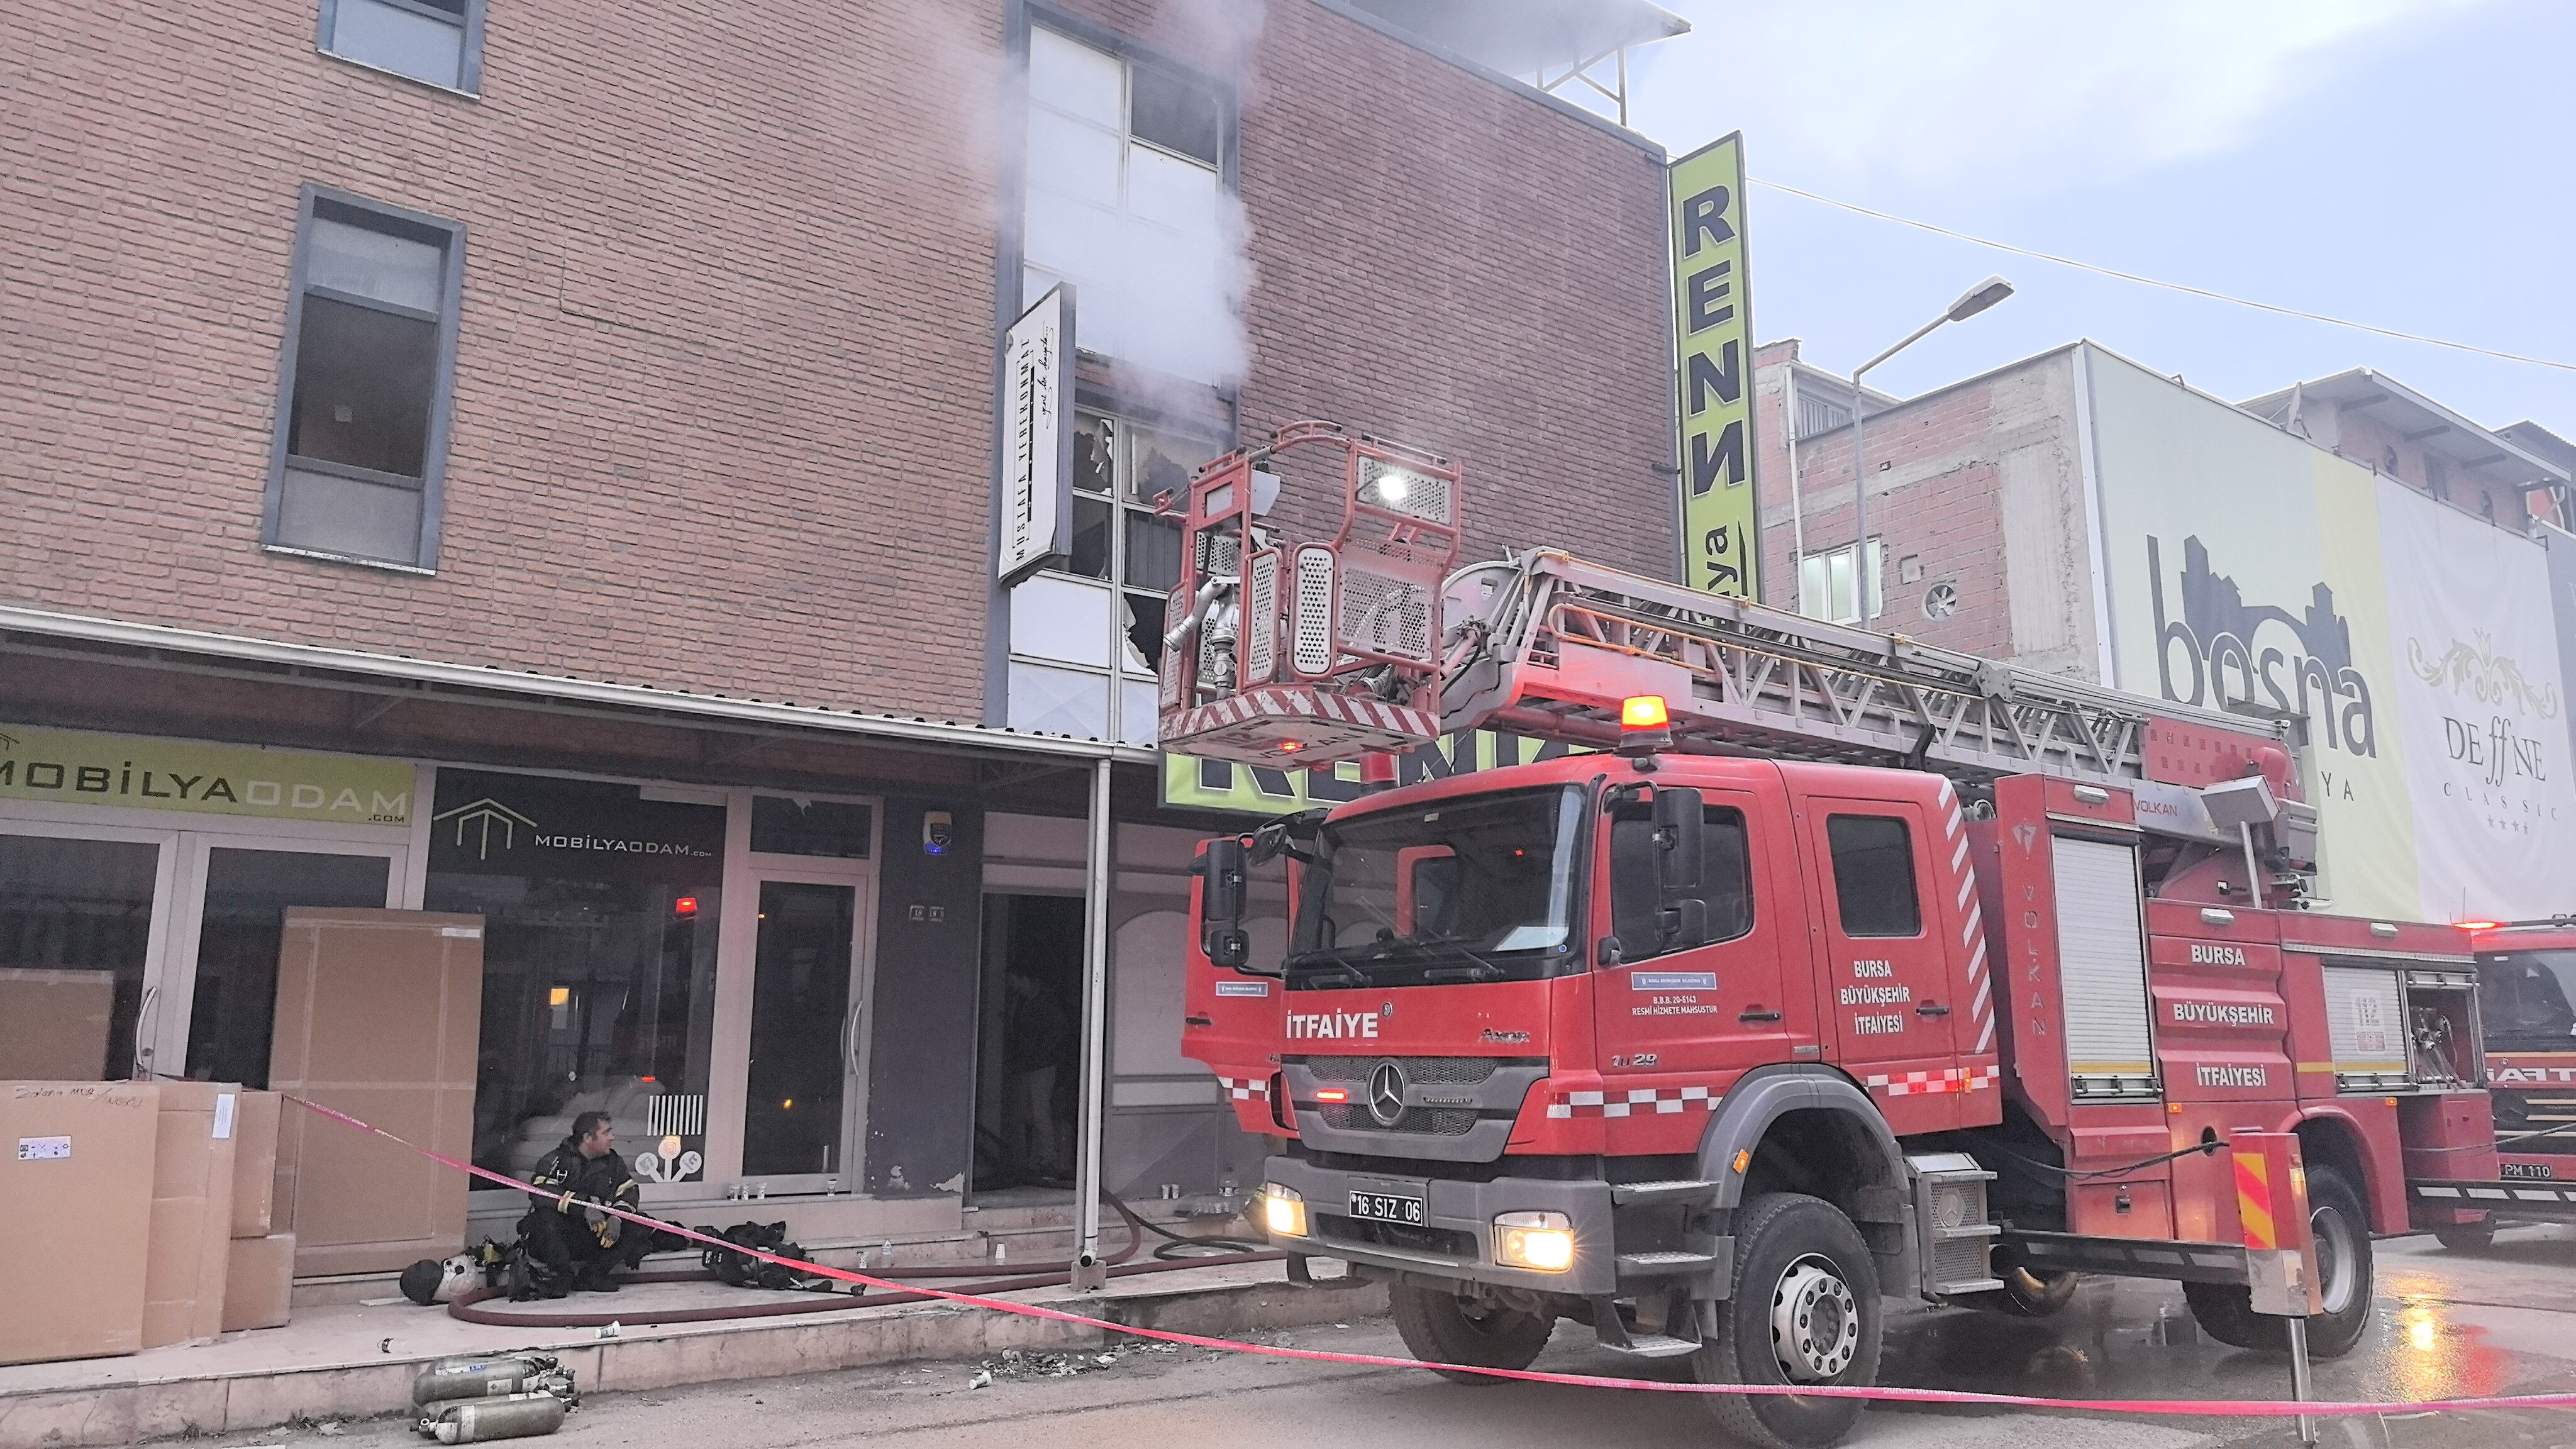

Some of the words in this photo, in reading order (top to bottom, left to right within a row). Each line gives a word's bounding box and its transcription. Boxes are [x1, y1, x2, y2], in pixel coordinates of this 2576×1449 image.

[1016, 474, 1026, 561] MUSTAFA
[2146, 534, 2377, 758] bosna
[2133, 799, 2178, 817] VOLKAN
[2443, 782, 2557, 821] CLASSIC
[1853, 959, 1892, 979] BURSA
[2023, 884, 2046, 1036] VOLKAN
[2190, 945, 2246, 967] BURSA
[1840, 983, 1911, 1008] BÜYÜKŞEHİR
[1285, 1008, 1379, 1038] İTFAİYE
[1632, 1006, 1652, 1016] RESMİ
[1653, 1005, 1680, 1015] HİZMETE
[1680, 1005, 1718, 1014] MAHSUSTUR
[1854, 1009, 1904, 1035] İTFAİYESİ
[2174, 1000, 2274, 1028] BÜYÜKŞEHİR
[2196, 1062, 2267, 1087] İTFAİYESİ
[2505, 1164, 2523, 1176] PM
[2528, 1165, 2551, 1177] 110
[1357, 1195, 1369, 1215] 16
[1374, 1197, 1397, 1219] SIZ
[1405, 1201, 1421, 1222] 06
